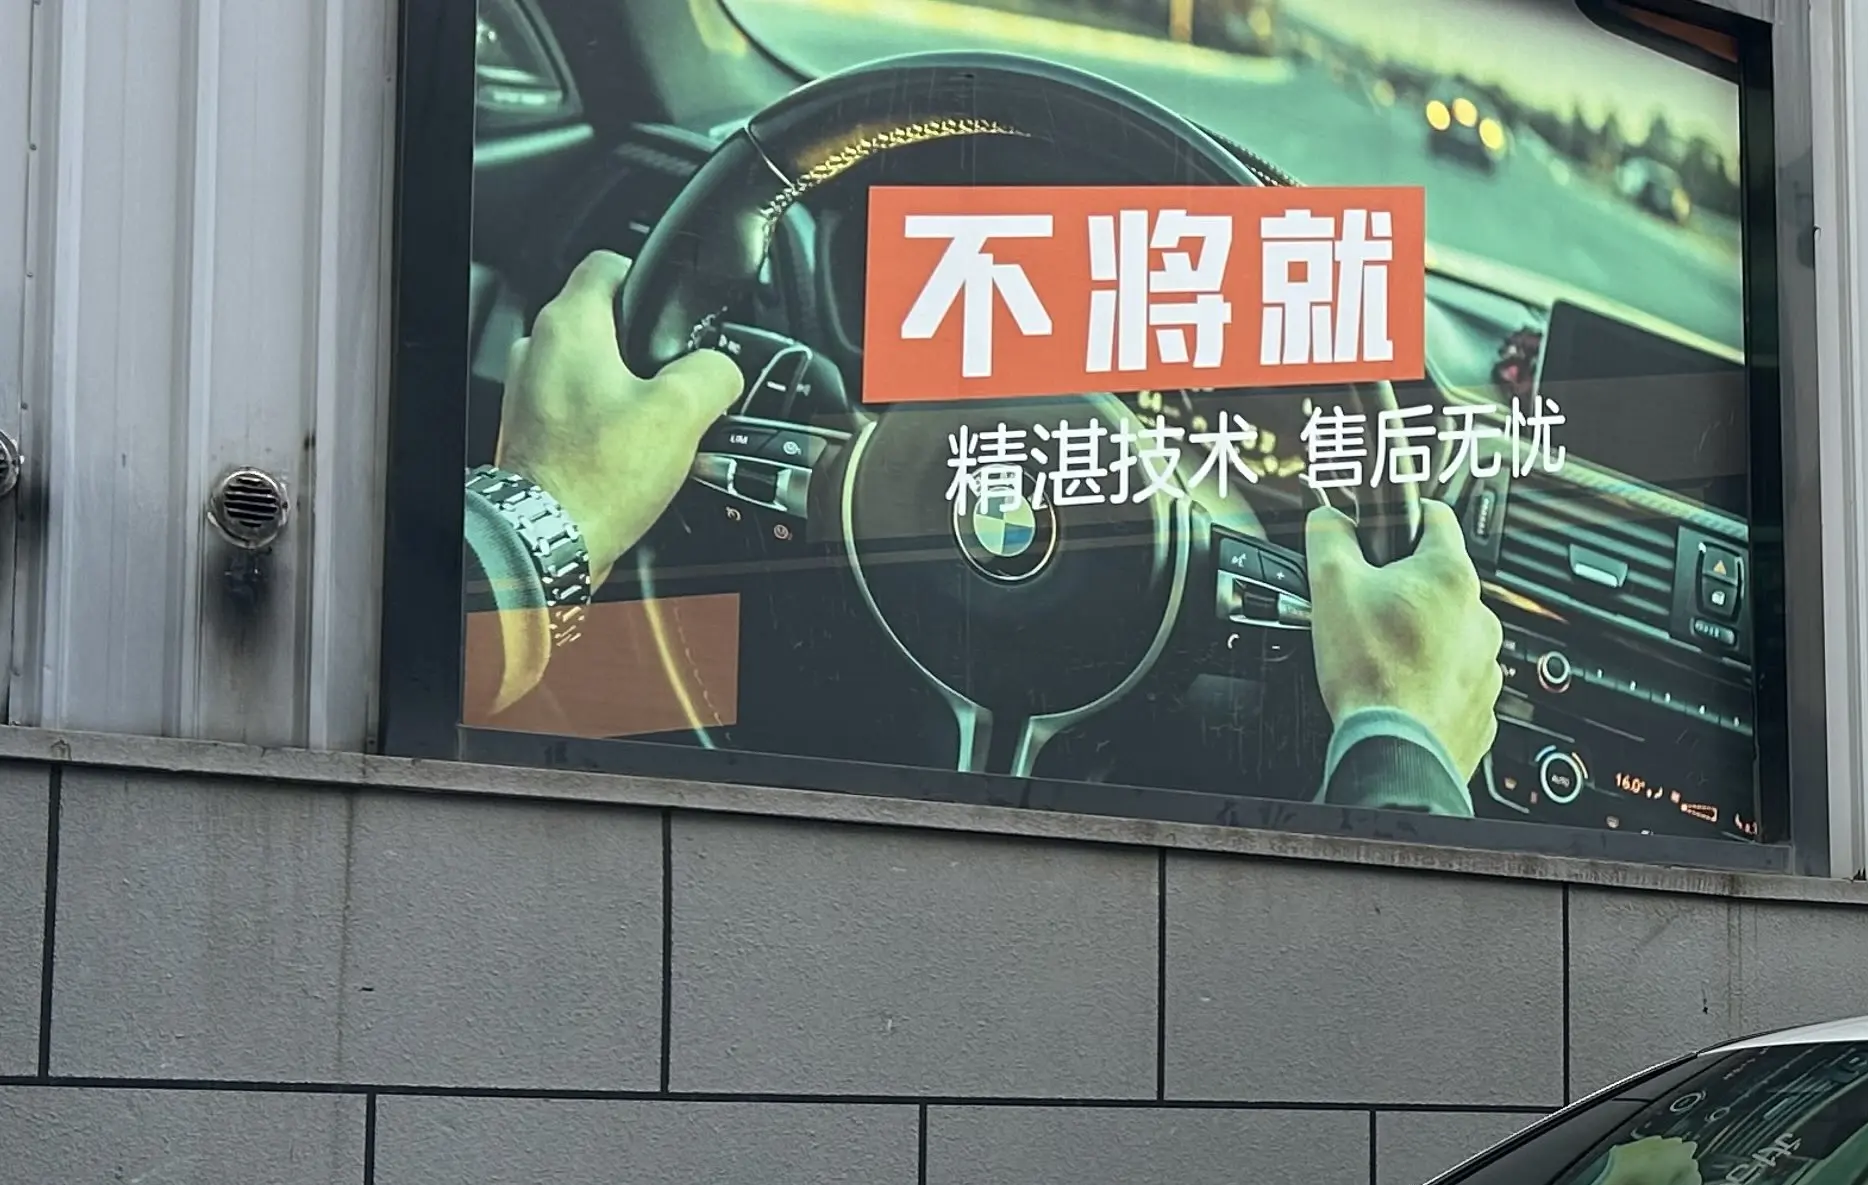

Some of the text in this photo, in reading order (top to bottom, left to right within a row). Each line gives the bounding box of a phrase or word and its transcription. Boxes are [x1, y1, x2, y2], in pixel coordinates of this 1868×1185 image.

[901, 206, 1394, 380] 不将就
[945, 396, 1567, 517] 精湛技术 售后无忧
